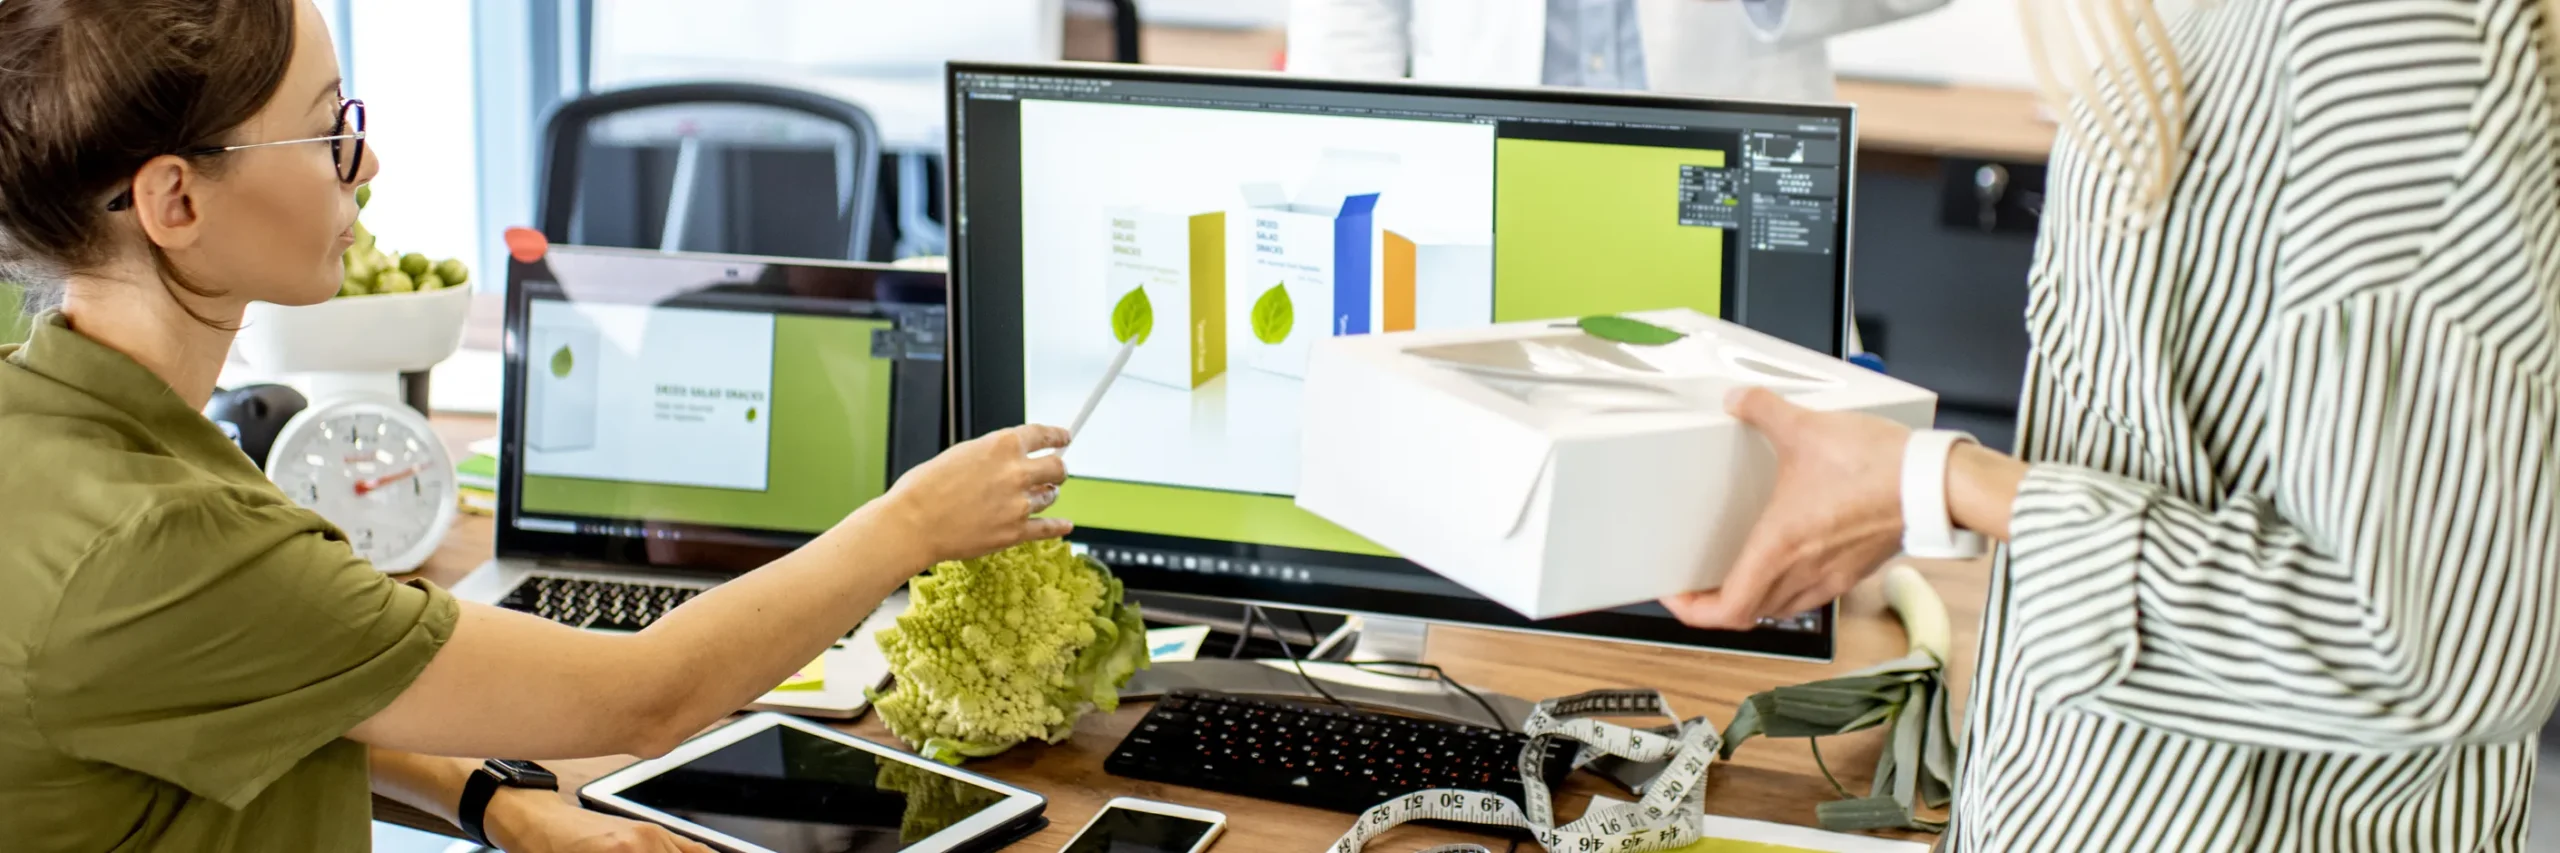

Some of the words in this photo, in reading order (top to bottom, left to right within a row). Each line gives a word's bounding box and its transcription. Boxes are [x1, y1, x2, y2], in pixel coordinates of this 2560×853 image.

[1663, 780, 1683, 802] 20
[1685, 756, 1704, 776] 21
[1404, 795, 1424, 811] 51
[1440, 793, 1464, 808] 50
[1481, 797, 1504, 812] 49
[1372, 806, 1390, 824] 52
[1600, 818, 1621, 835] 16
[1540, 832, 1562, 847] 47
[1579, 837, 1604, 851] 46
[1621, 837, 1643, 850] 45
